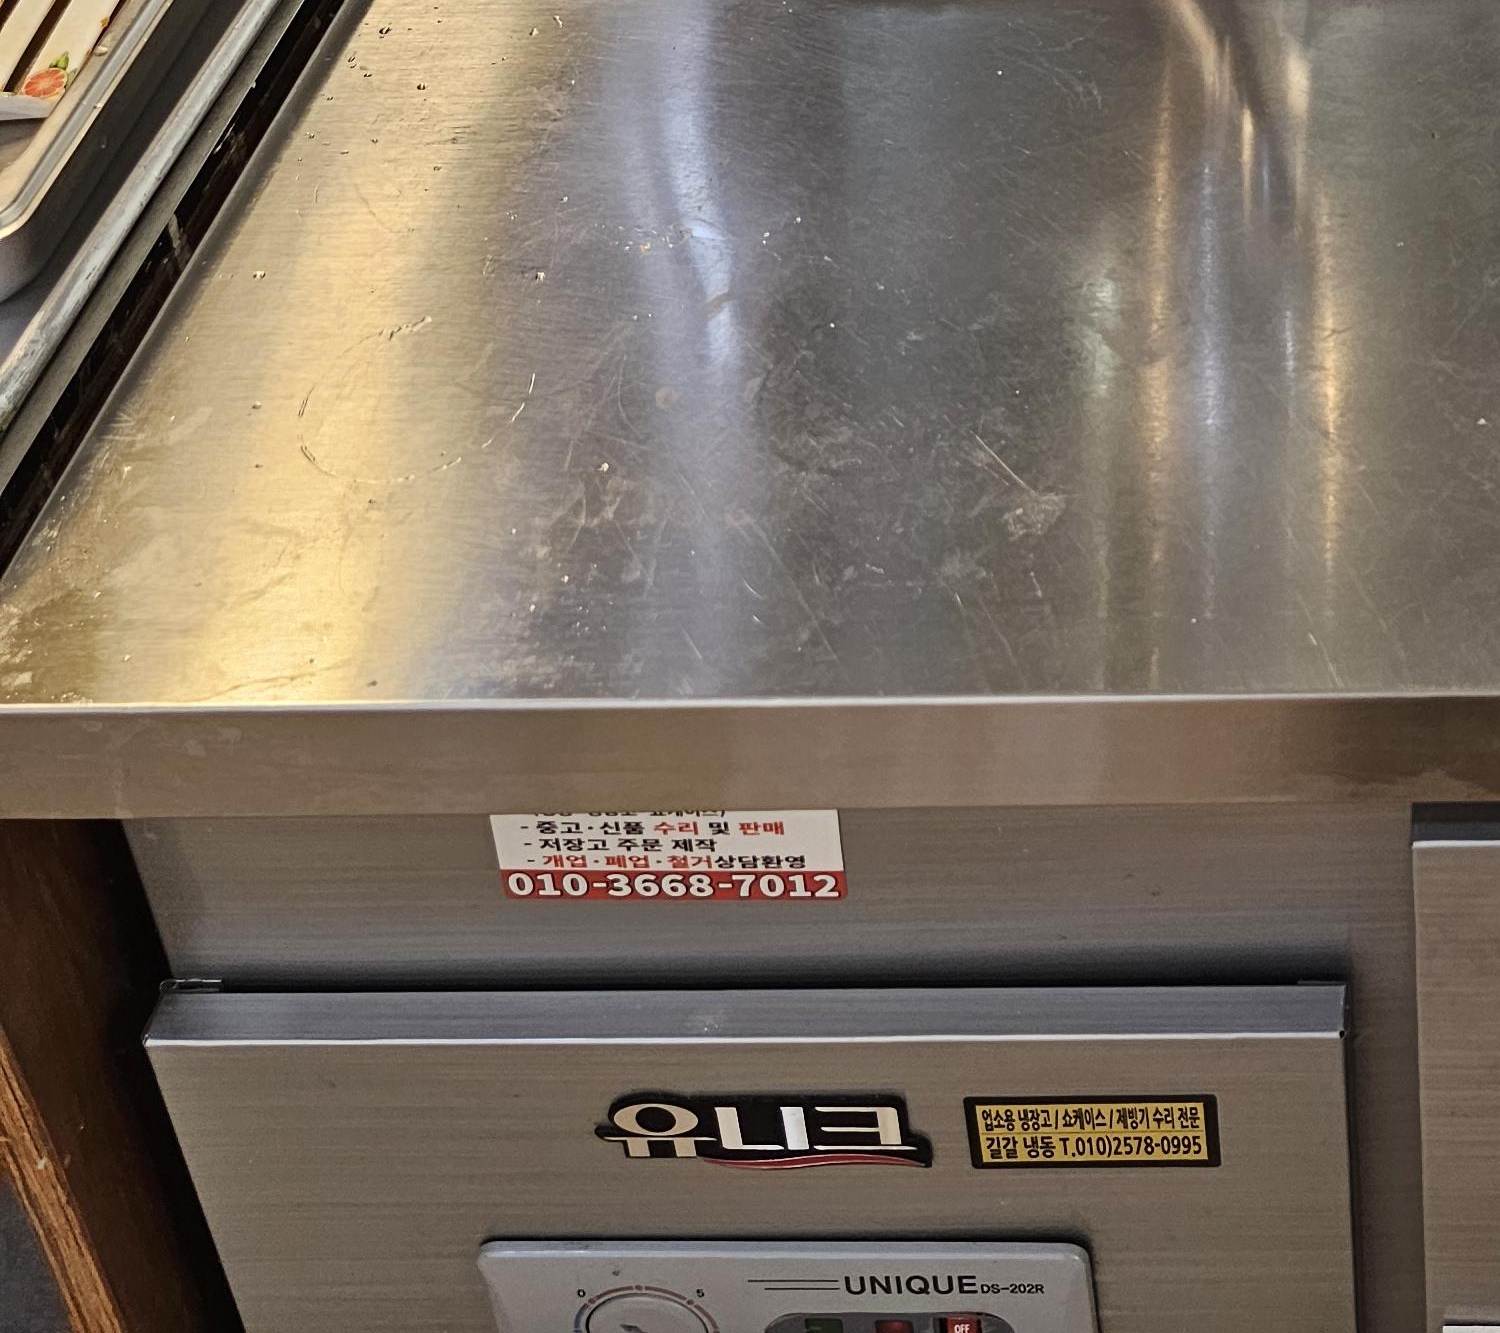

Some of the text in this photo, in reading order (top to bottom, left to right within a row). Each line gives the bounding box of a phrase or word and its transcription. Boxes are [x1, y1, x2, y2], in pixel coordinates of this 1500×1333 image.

[654, 821, 698, 836] 수리
[708, 821, 731, 836] 및
[738, 820, 785, 836] 판매
[539, 838, 718, 852] 저장고 주문 제작
[508, 872, 840, 898] 010-3668-7012
[982, 1109, 1015, 1132] 업소용
[1018, 1109, 1053, 1132] 냉장고
[1062, 1108, 1107, 1130] 쇼케이스
[1116, 1107, 1150, 1130] 제빙기
[1152, 1107, 1175, 1129] 수리
[1177, 1106, 1200, 1129] 전문
[605, 1104, 918, 1158] 유니크
[986, 1137, 1019, 1159] 길갈
[1023, 1136, 1056, 1159] 냉동
[844, 1275, 1045, 1296] UNIQUE DS-202R
